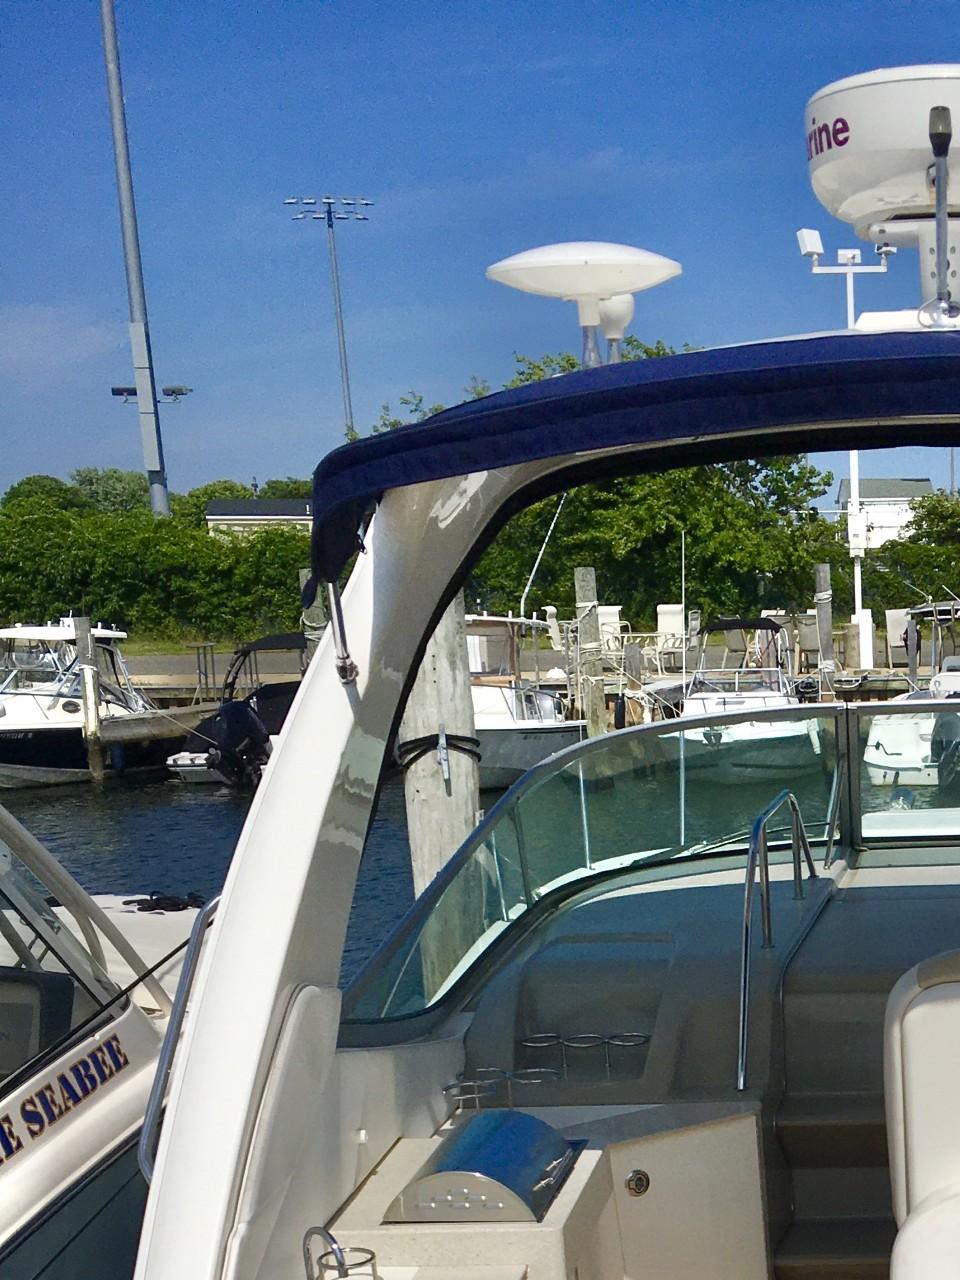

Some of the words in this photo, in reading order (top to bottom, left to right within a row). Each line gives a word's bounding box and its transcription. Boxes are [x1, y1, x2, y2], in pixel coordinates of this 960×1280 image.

[807, 117, 849, 161] rine
[0, 1113, 24, 1166] E
[20, 1033, 130, 1140] SEABEE
